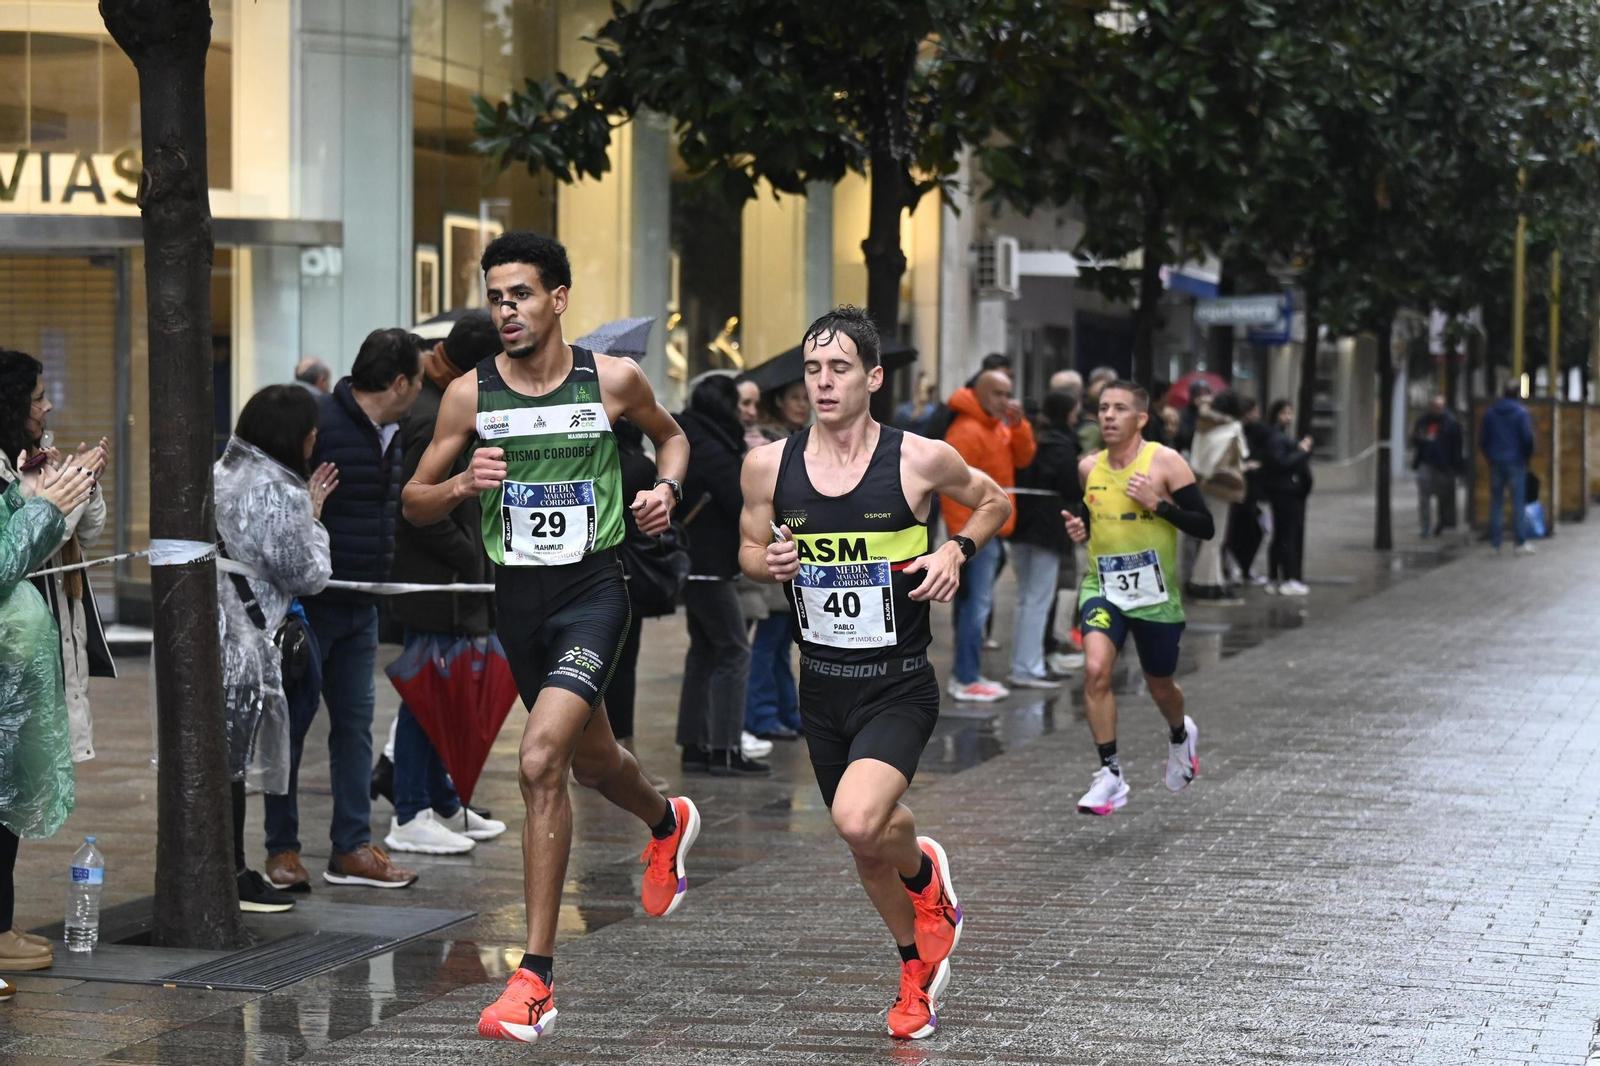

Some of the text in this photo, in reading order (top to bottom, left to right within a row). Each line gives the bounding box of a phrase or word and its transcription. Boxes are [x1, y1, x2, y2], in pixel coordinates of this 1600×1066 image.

[0, 149, 140, 203] VIAS
[544, 443, 596, 459] CORDOBÉS
[543, 484, 575, 493] MEDIA
[530, 511, 566, 538] 29
[534, 543, 564, 551] MAHMUD
[797, 538, 868, 562] ASM
[835, 565, 869, 574] MEDIA
[1117, 572, 1140, 591] 37
[823, 591, 861, 618] 40
